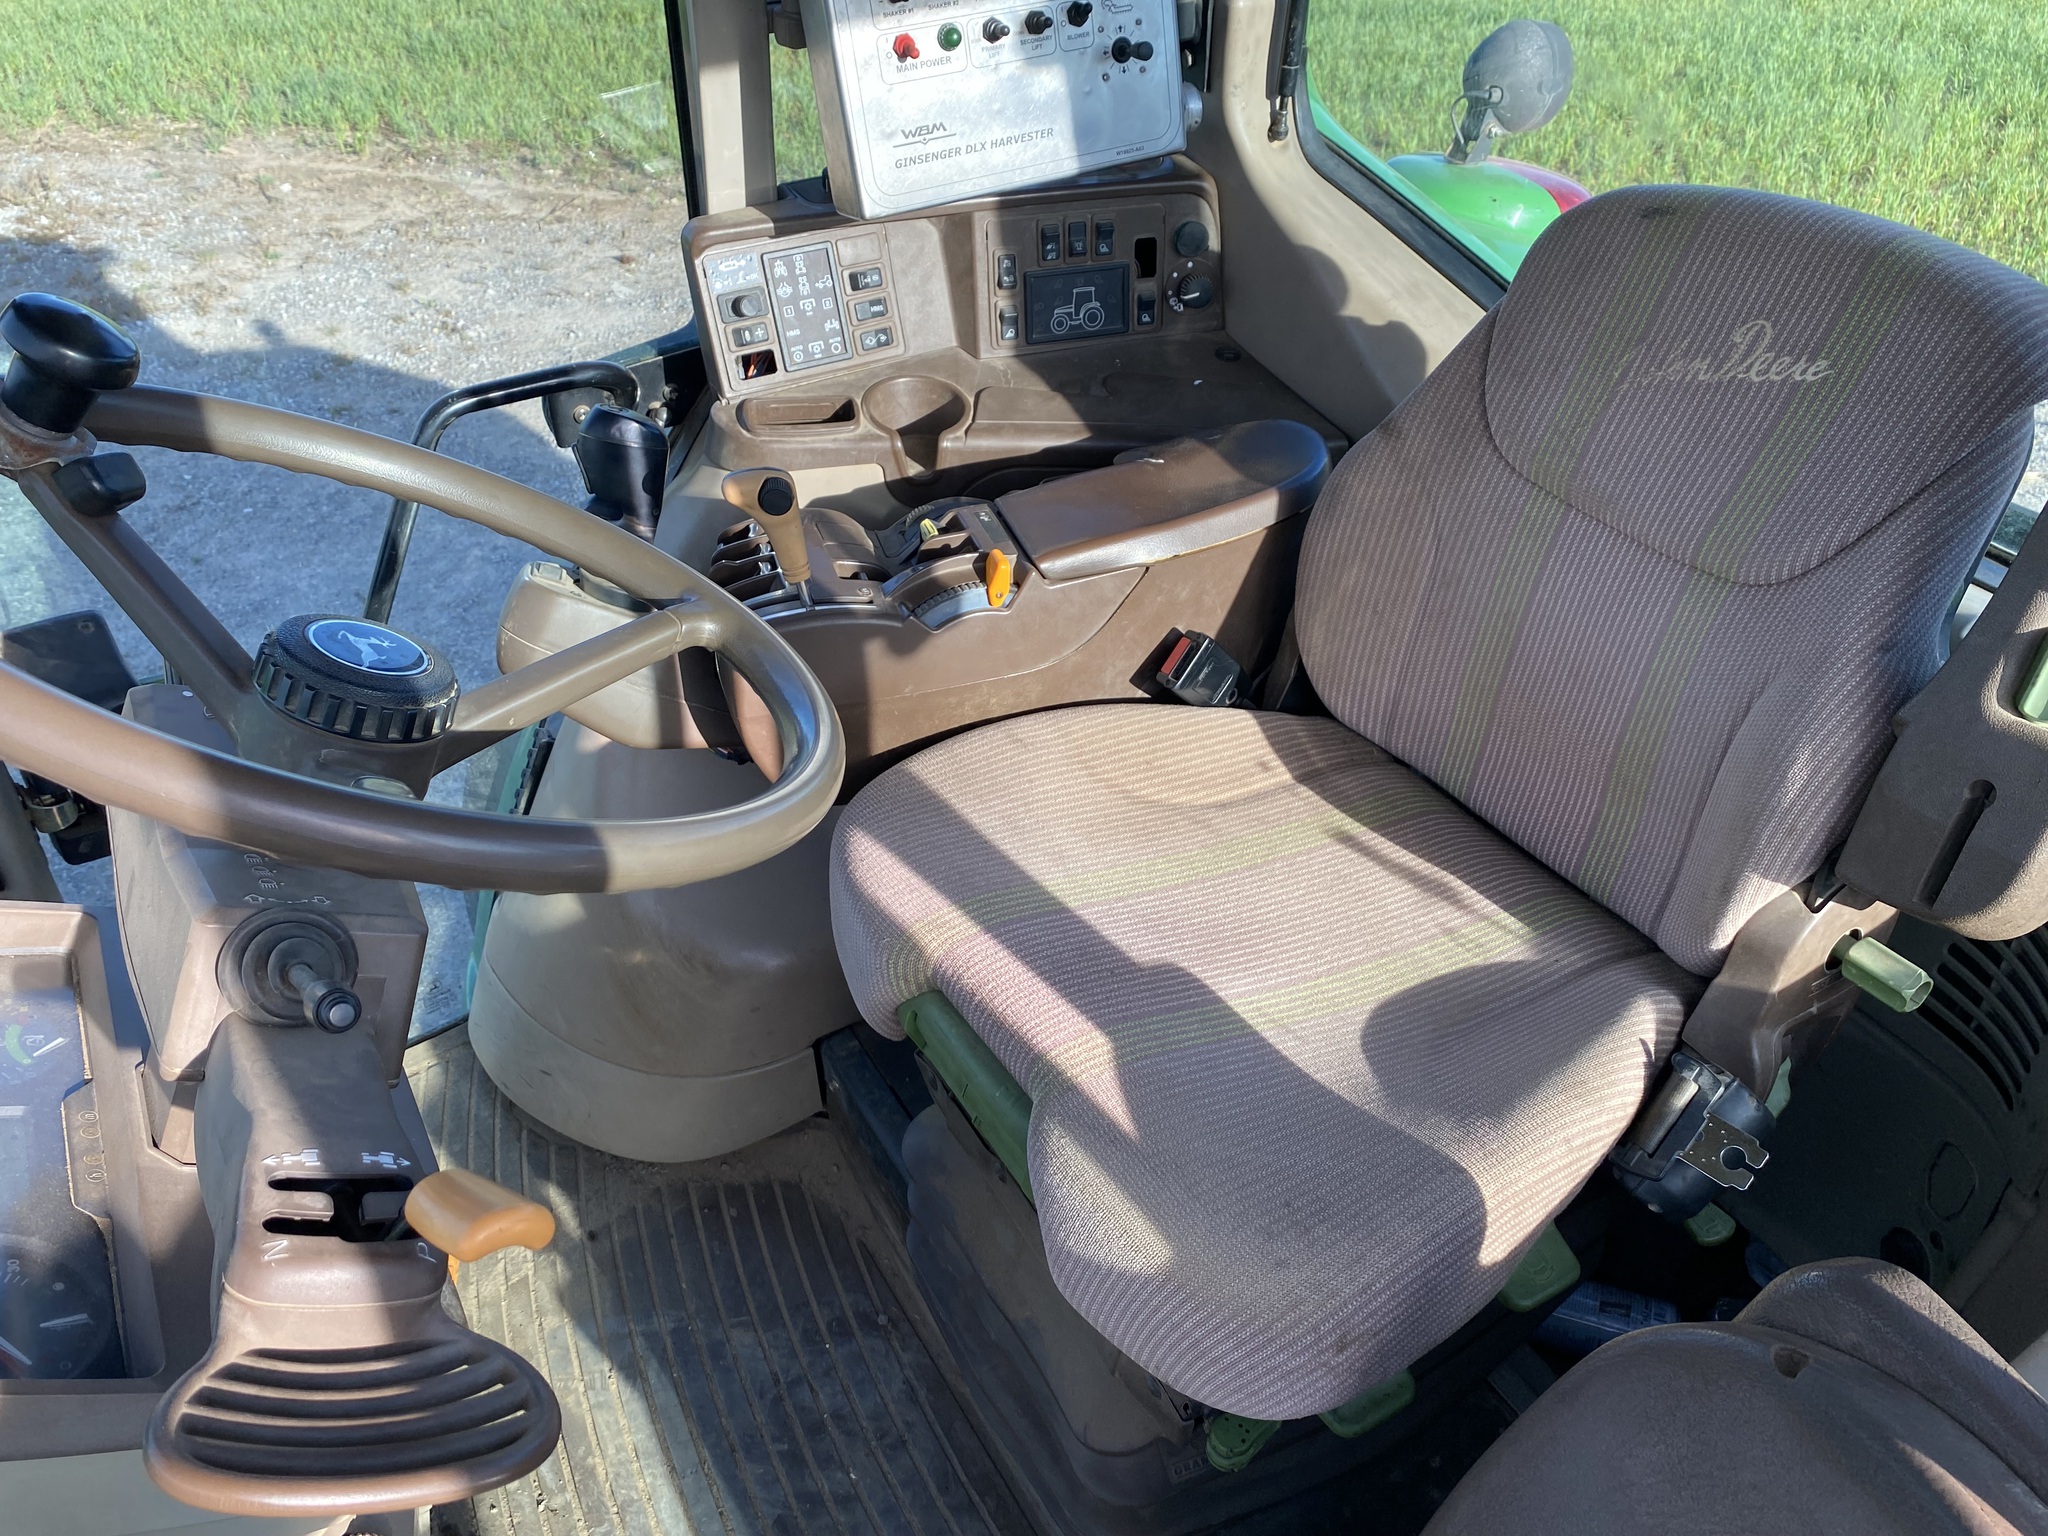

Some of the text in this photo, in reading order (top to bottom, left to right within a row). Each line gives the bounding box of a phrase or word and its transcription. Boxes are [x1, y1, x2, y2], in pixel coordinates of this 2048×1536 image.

[928, 2, 952, 10] SHAKER
[882, 9, 907, 18] SHAKER
[1020, 35, 1053, 46] SECONDARY
[1067, 32, 1090, 40] BLOWER
[981, 44, 1006, 53] PRIMARY
[896, 56, 952, 73] MAIN POWER
[901, 121, 948, 140] WBM
[894, 127, 1055, 169] GINSENGER DLX HARVESTER
[786, 328, 801, 337] HMS
[1717, 320, 1833, 382] Deere
[261, 1239, 289, 1262] N
[417, 1241, 437, 1263] P
[6, 1259, 20, 1273] 30
